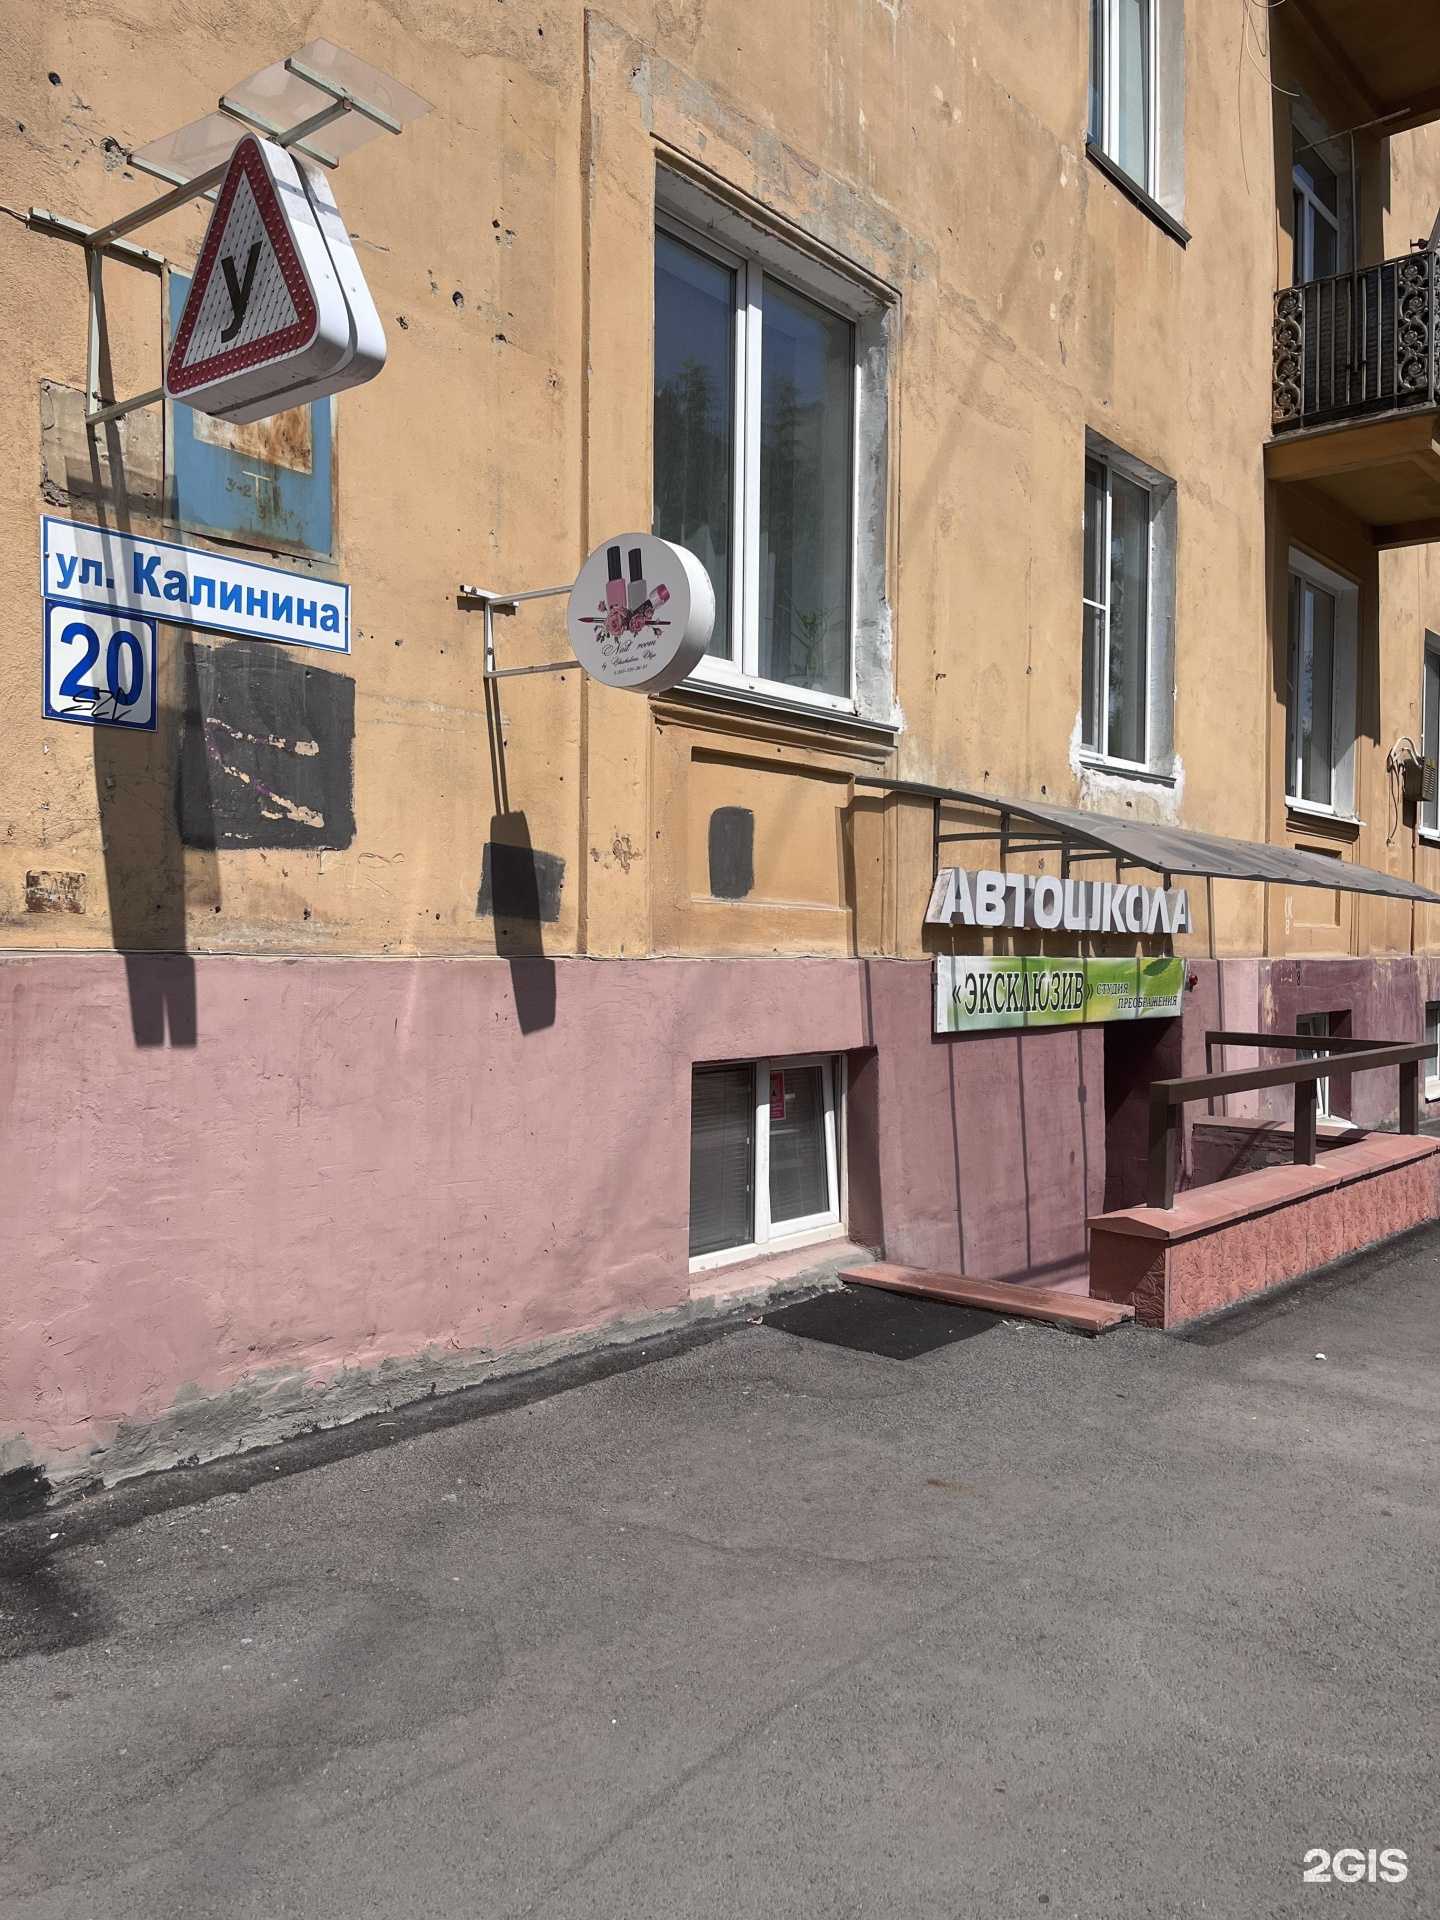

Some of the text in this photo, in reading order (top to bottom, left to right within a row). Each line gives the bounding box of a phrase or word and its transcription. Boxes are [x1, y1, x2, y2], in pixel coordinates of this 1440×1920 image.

[55, 551, 341, 634] ул. Калинина
[58, 622, 144, 707] 20
[934, 866, 1193, 935] АВТОШКОЛА
[1096, 983, 1129, 996] СТУДИЯ
[1117, 995, 1178, 1009] ПРЕОБРАЖЕНИЯ
